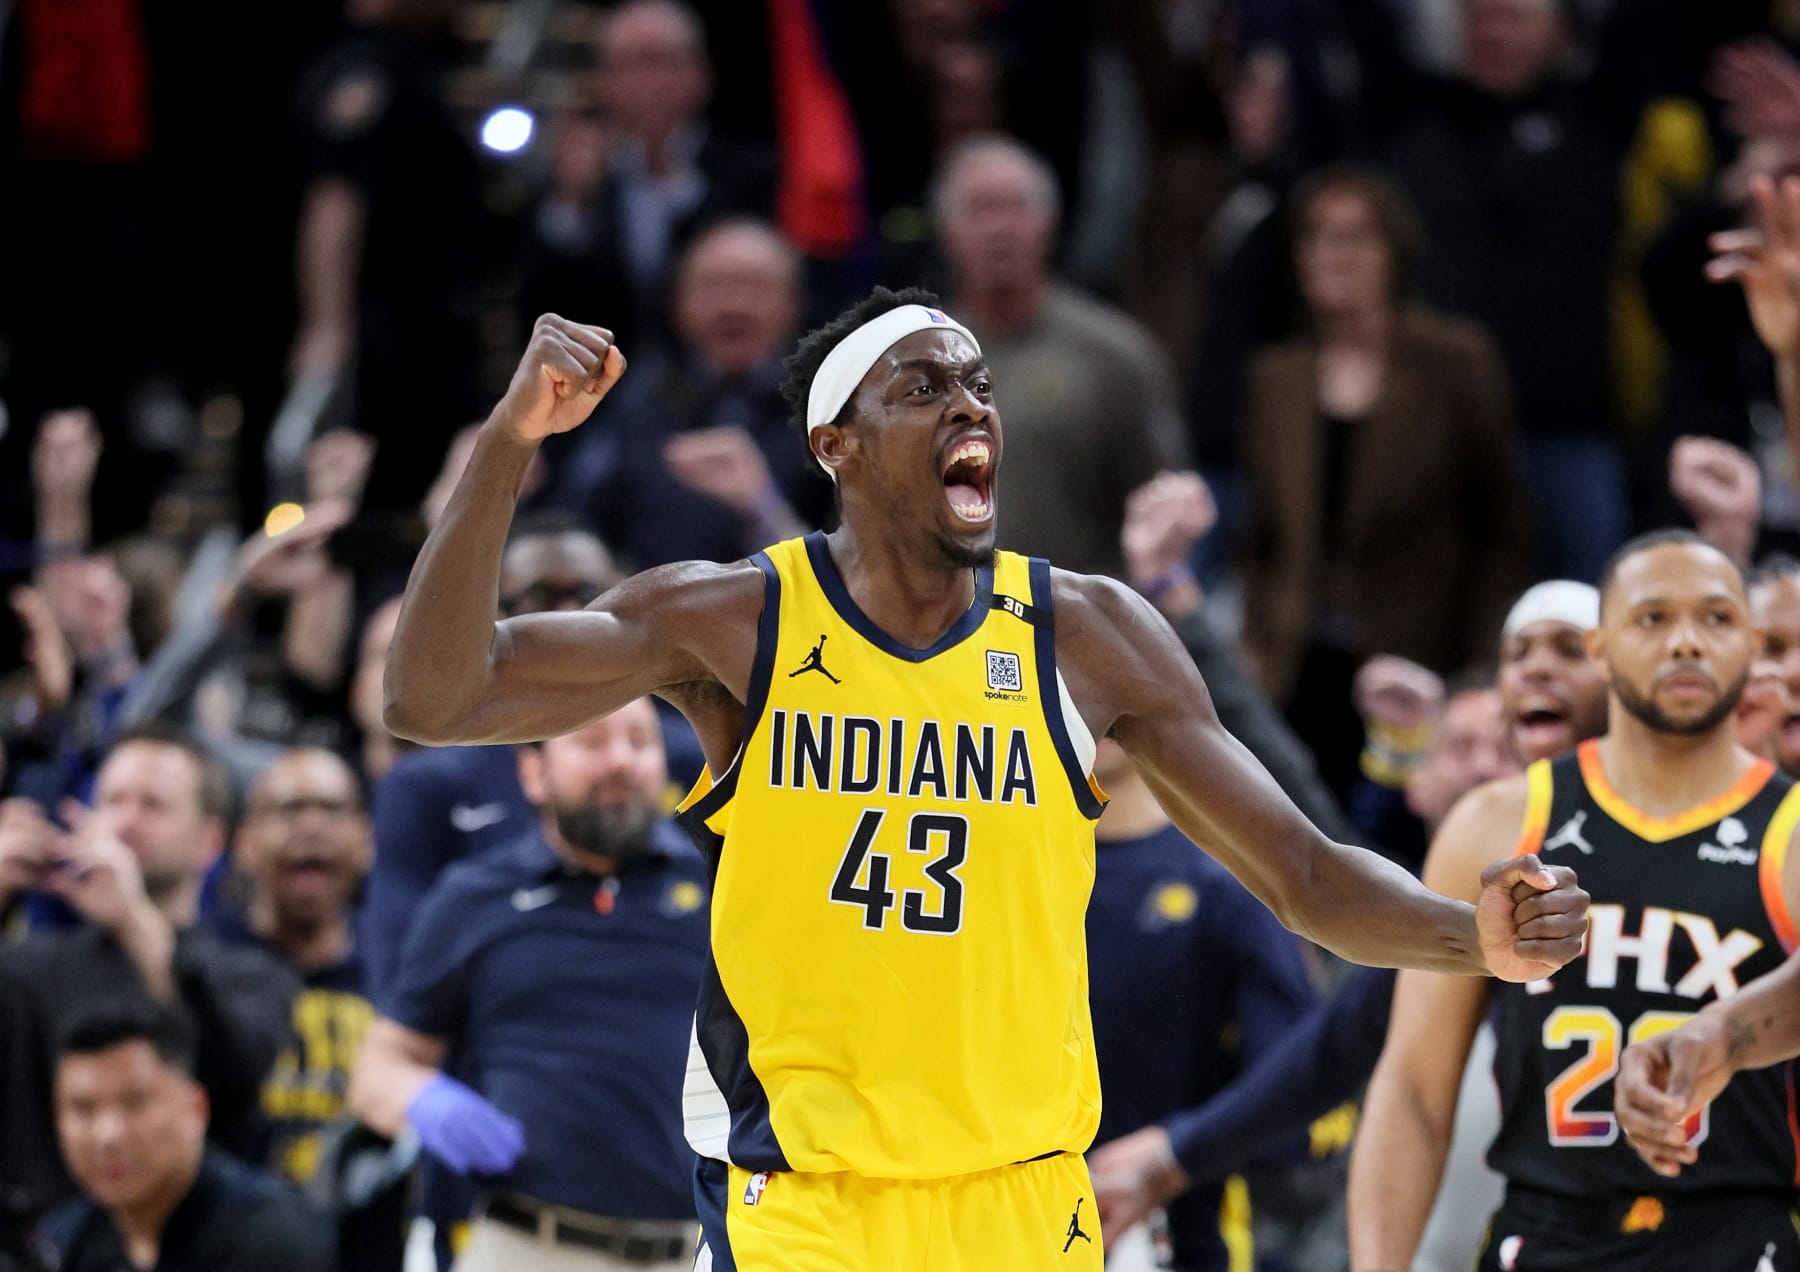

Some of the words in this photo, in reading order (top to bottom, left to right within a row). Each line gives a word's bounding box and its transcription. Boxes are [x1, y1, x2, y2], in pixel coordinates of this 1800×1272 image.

[1003, 597, 1024, 618] 30
[984, 690, 1028, 702] spokenote
[769, 708, 1038, 808] INDIANA
[828, 807, 970, 936] 43
[1526, 903, 1764, 1001] HX
[1542, 1005, 1709, 1147] 2
